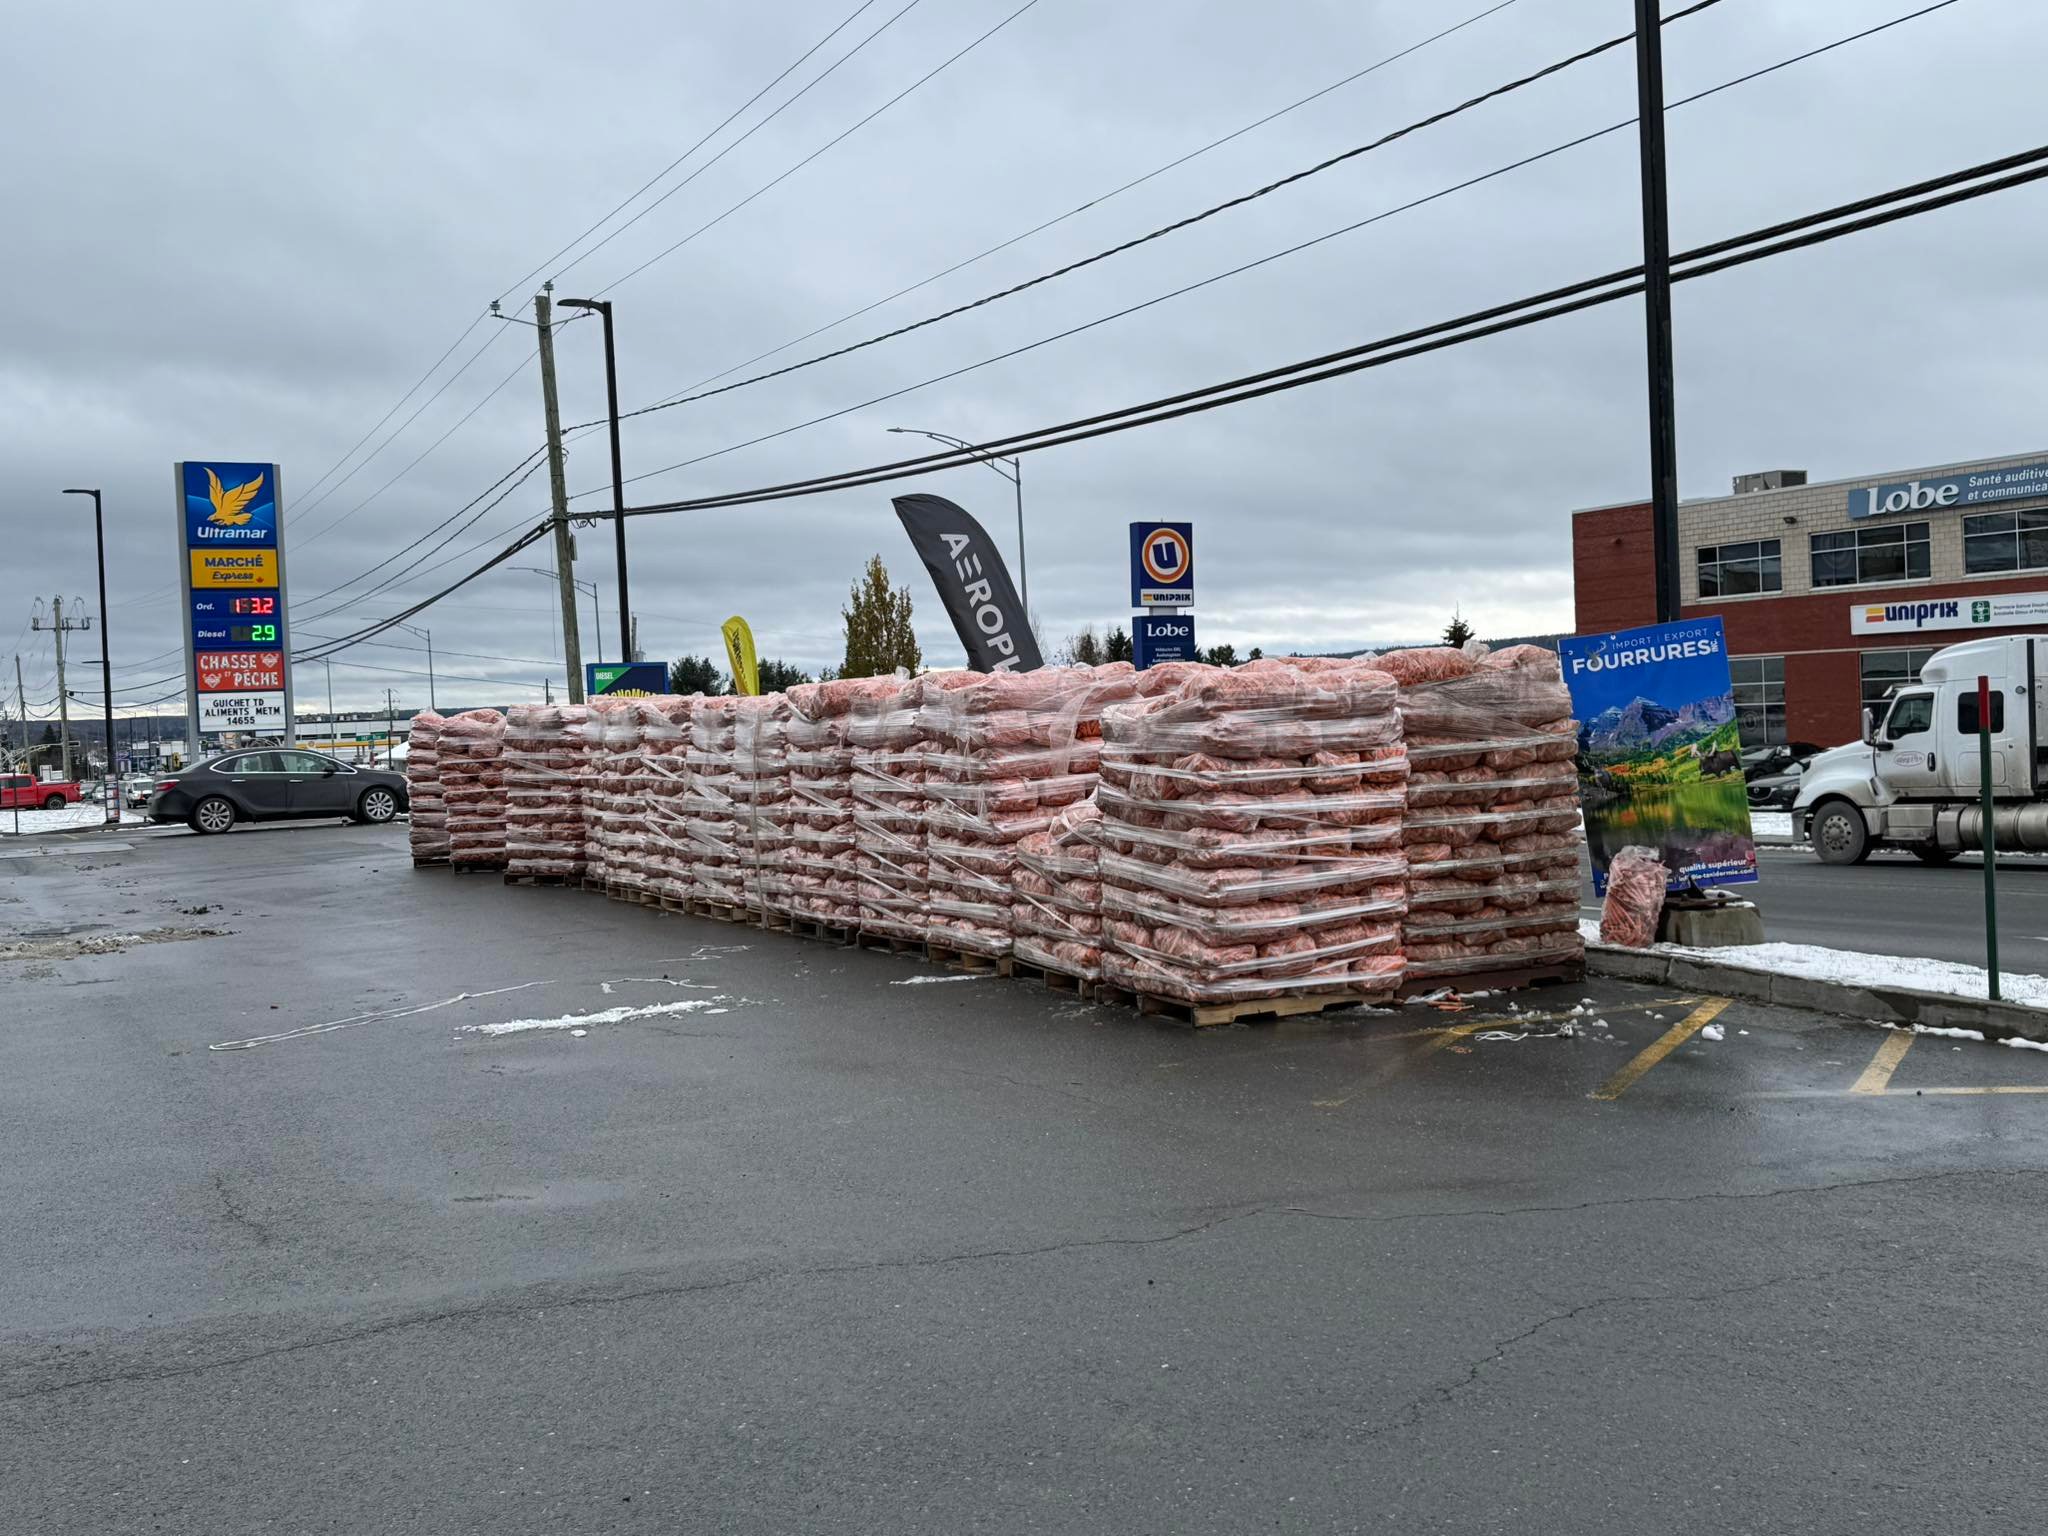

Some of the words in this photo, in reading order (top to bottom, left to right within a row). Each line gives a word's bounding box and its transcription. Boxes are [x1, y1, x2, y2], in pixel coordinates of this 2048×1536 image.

[1969, 474, 2001, 487] Santé
[1867, 481, 1959, 515] Lobe
[1968, 490, 1978, 501] et
[197, 526, 267, 539] Ultramar
[205, 553, 263, 568] MARCHÉ
[212, 571, 253, 582] Express
[196, 603, 215, 611] Ord.
[198, 629, 226, 638] Diesel
[1147, 623, 1189, 637] Lobe
[1612, 636, 1651, 650] IMPORT
[1664, 628, 1708, 642] EXPORT
[200, 654, 257, 670] CHASSE
[1572, 639, 1712, 674] FOURRURES
[233, 669, 279, 686] PÊCHE
[595, 672, 614, 680] DIESEL
[213, 699, 249, 708] GUICHET
[254, 698, 264, 707] TD
[205, 708, 249, 717] ALIMENTS
[227, 716, 255, 726] 14655
[1679, 862, 1706, 875] qualité
[1708, 859, 1747, 870] supérieur
